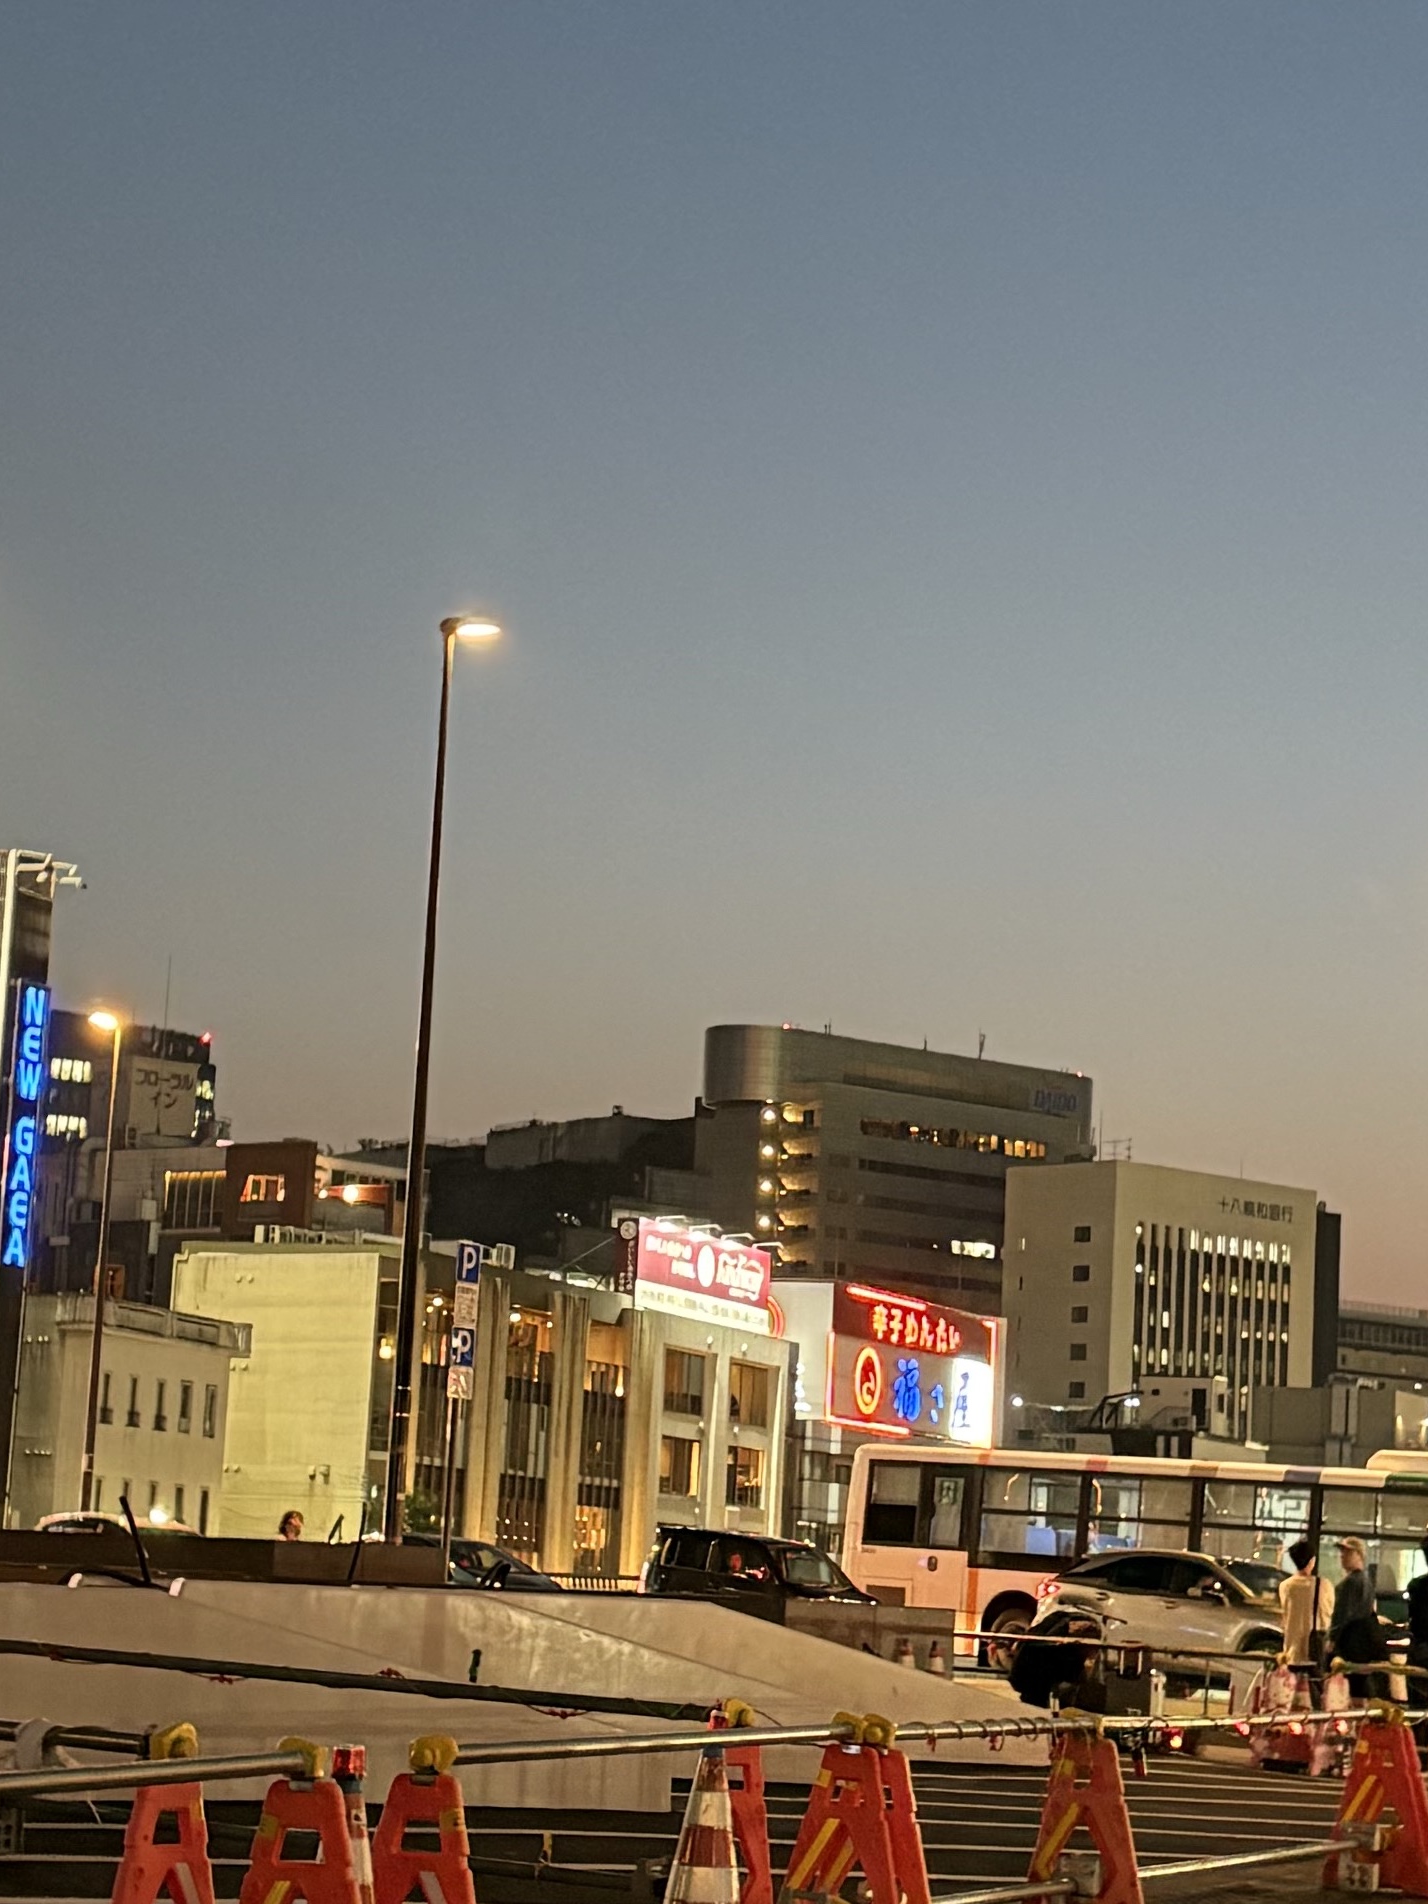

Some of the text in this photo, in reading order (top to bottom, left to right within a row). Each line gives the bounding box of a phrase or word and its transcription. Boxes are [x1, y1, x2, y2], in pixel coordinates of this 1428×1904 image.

[3, 986, 46, 1268] NEW GAEA
[462, 1246, 478, 1279] P
